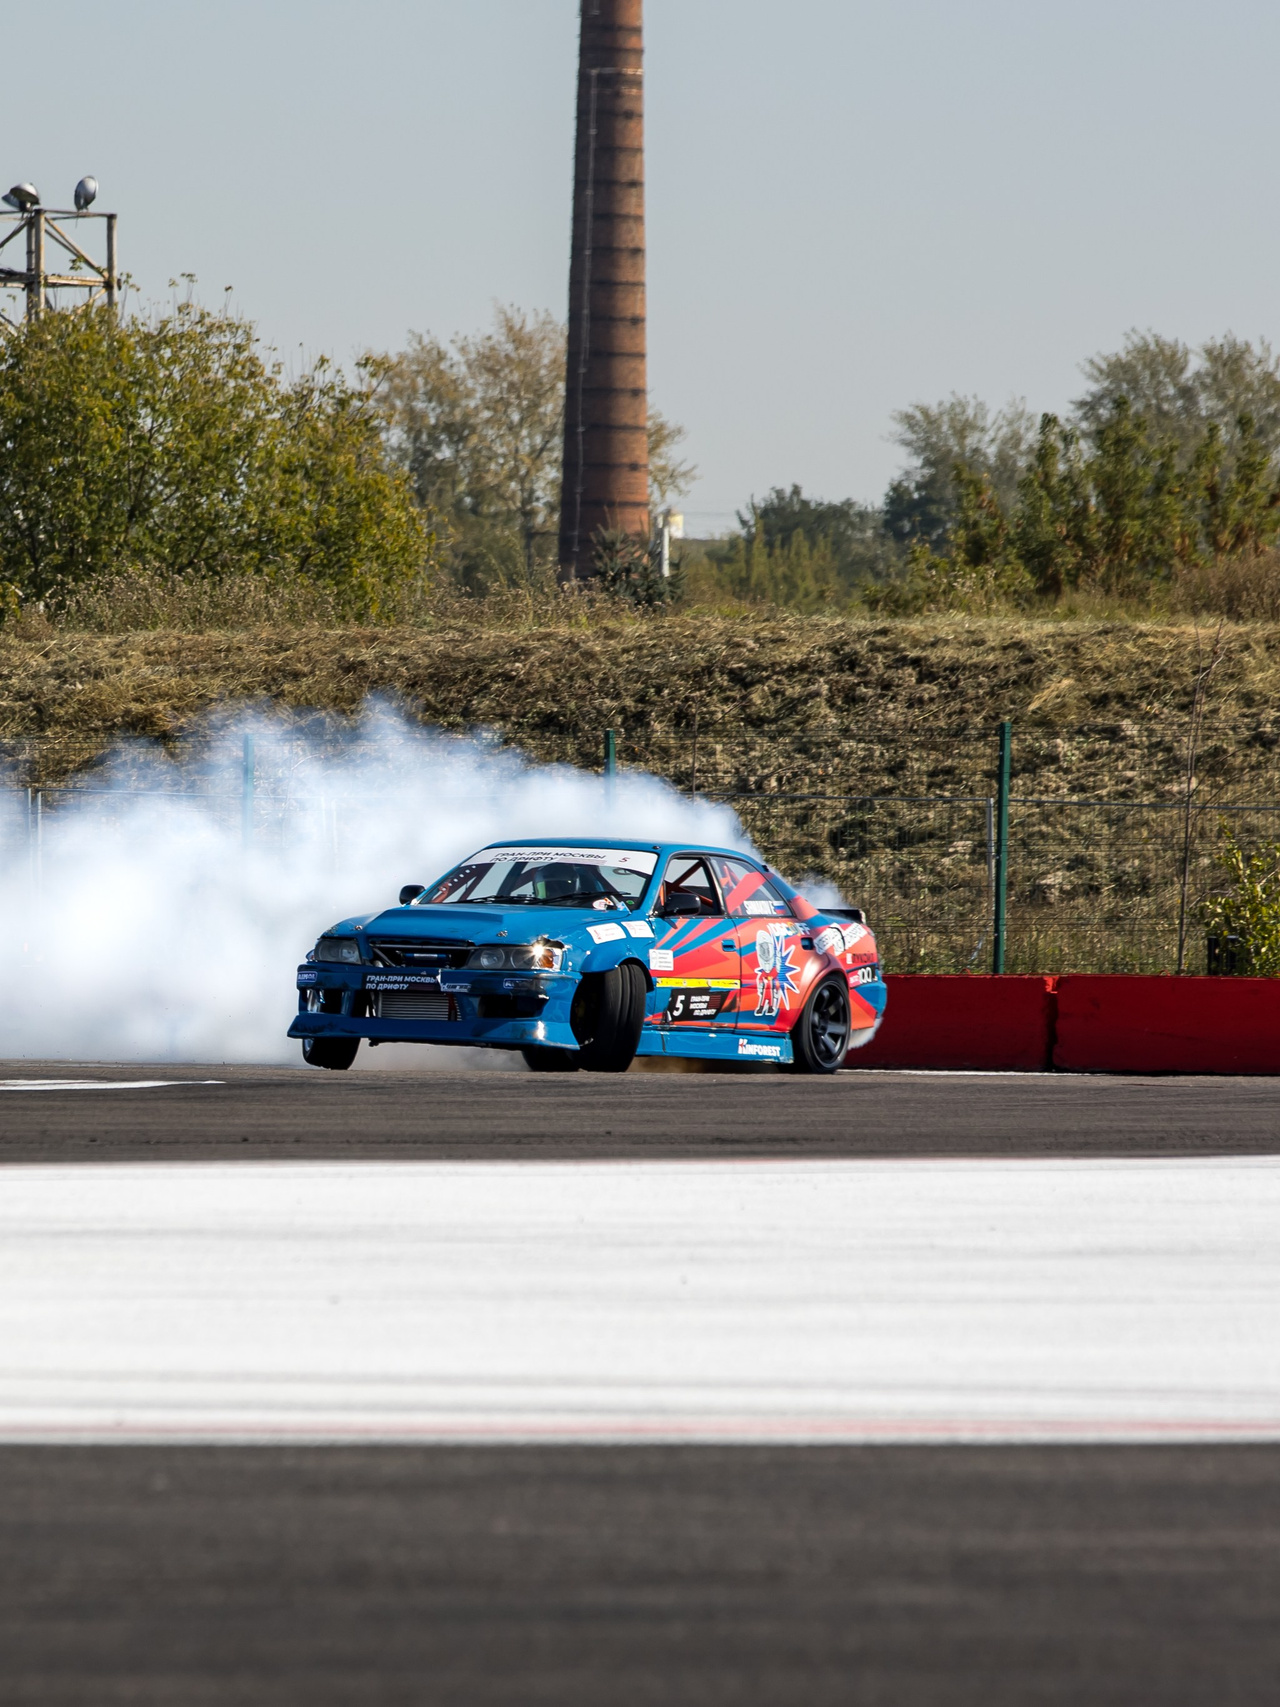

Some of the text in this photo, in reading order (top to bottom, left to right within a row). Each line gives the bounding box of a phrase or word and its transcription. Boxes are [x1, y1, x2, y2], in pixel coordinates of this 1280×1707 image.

[553, 852, 606, 860] МОСКВЫ
[366, 975, 403, 983] ГРАН-ПРИ
[377, 983, 409, 991] ДРИФТУ
[672, 995, 686, 1016] 5
